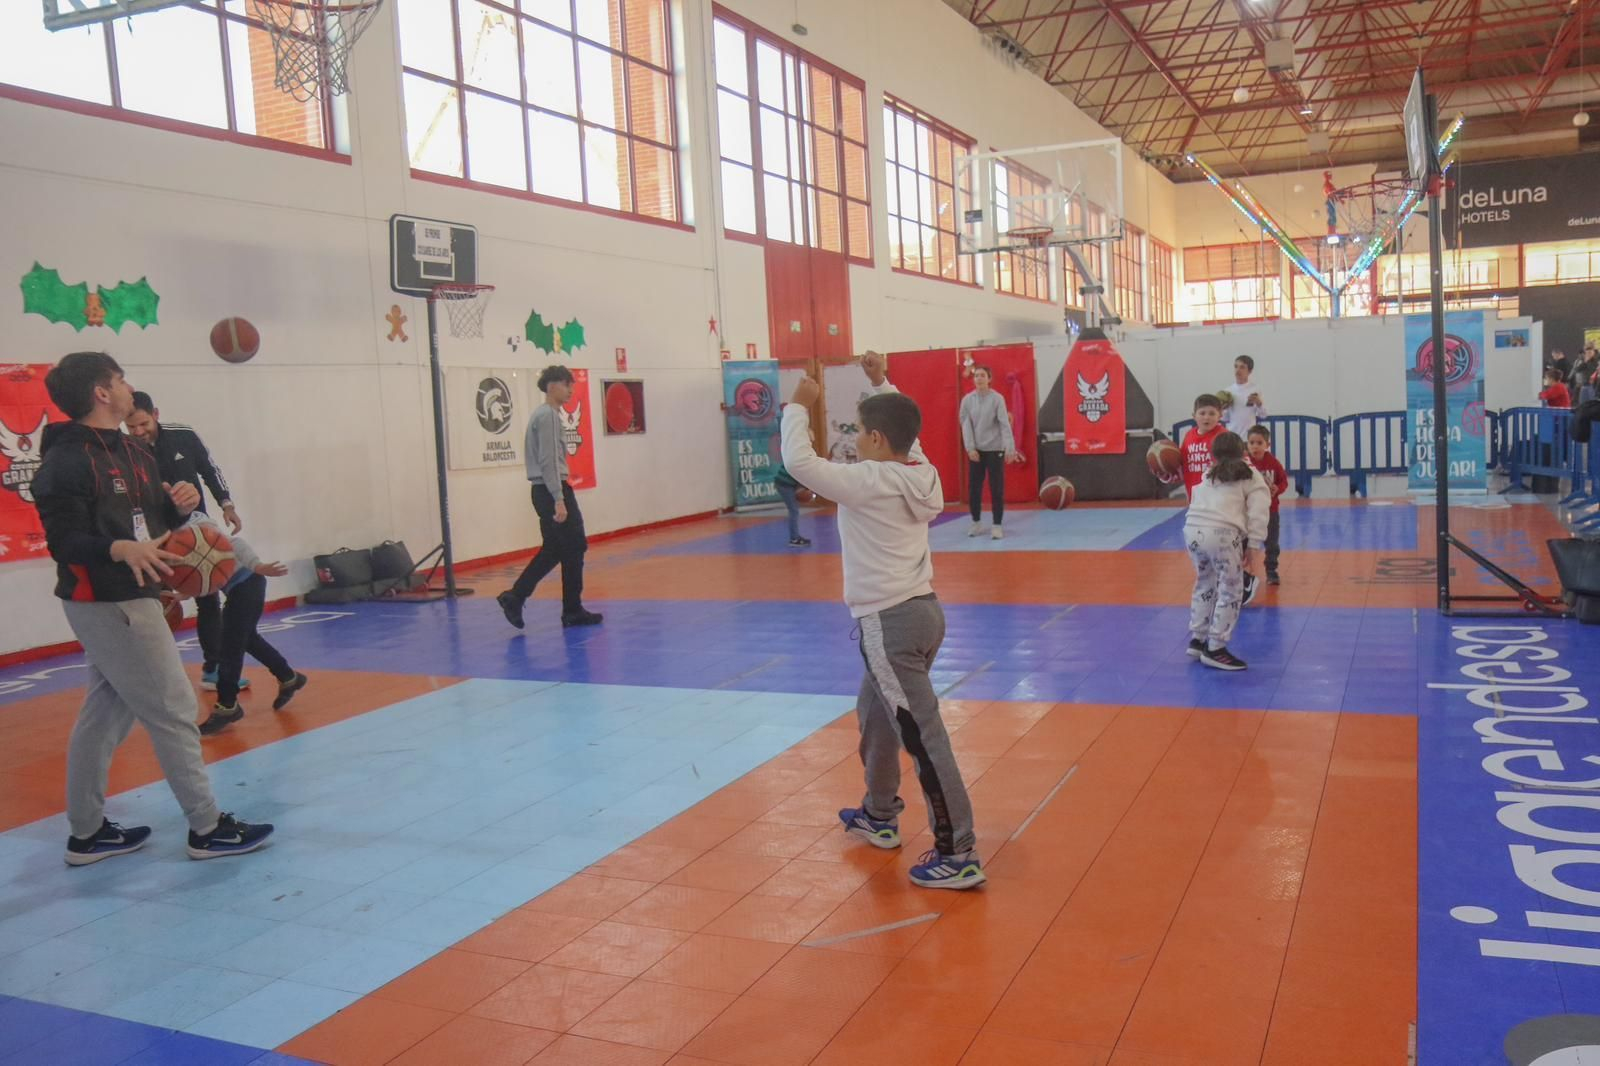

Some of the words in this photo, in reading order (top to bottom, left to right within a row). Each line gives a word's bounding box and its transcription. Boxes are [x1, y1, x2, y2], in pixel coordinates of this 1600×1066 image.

[1459, 186, 1548, 209] deLuna
[1461, 210, 1511, 224] HOTELS
[1416, 425, 1462, 443] HOA
[1187, 442, 1208, 454] WILL
[1416, 444, 1436, 461] DE
[739, 453, 770, 469] HORA
[1187, 452, 1212, 463] SANTA
[740, 468, 757, 484] DE
[1416, 460, 1476, 479] JUAR!
